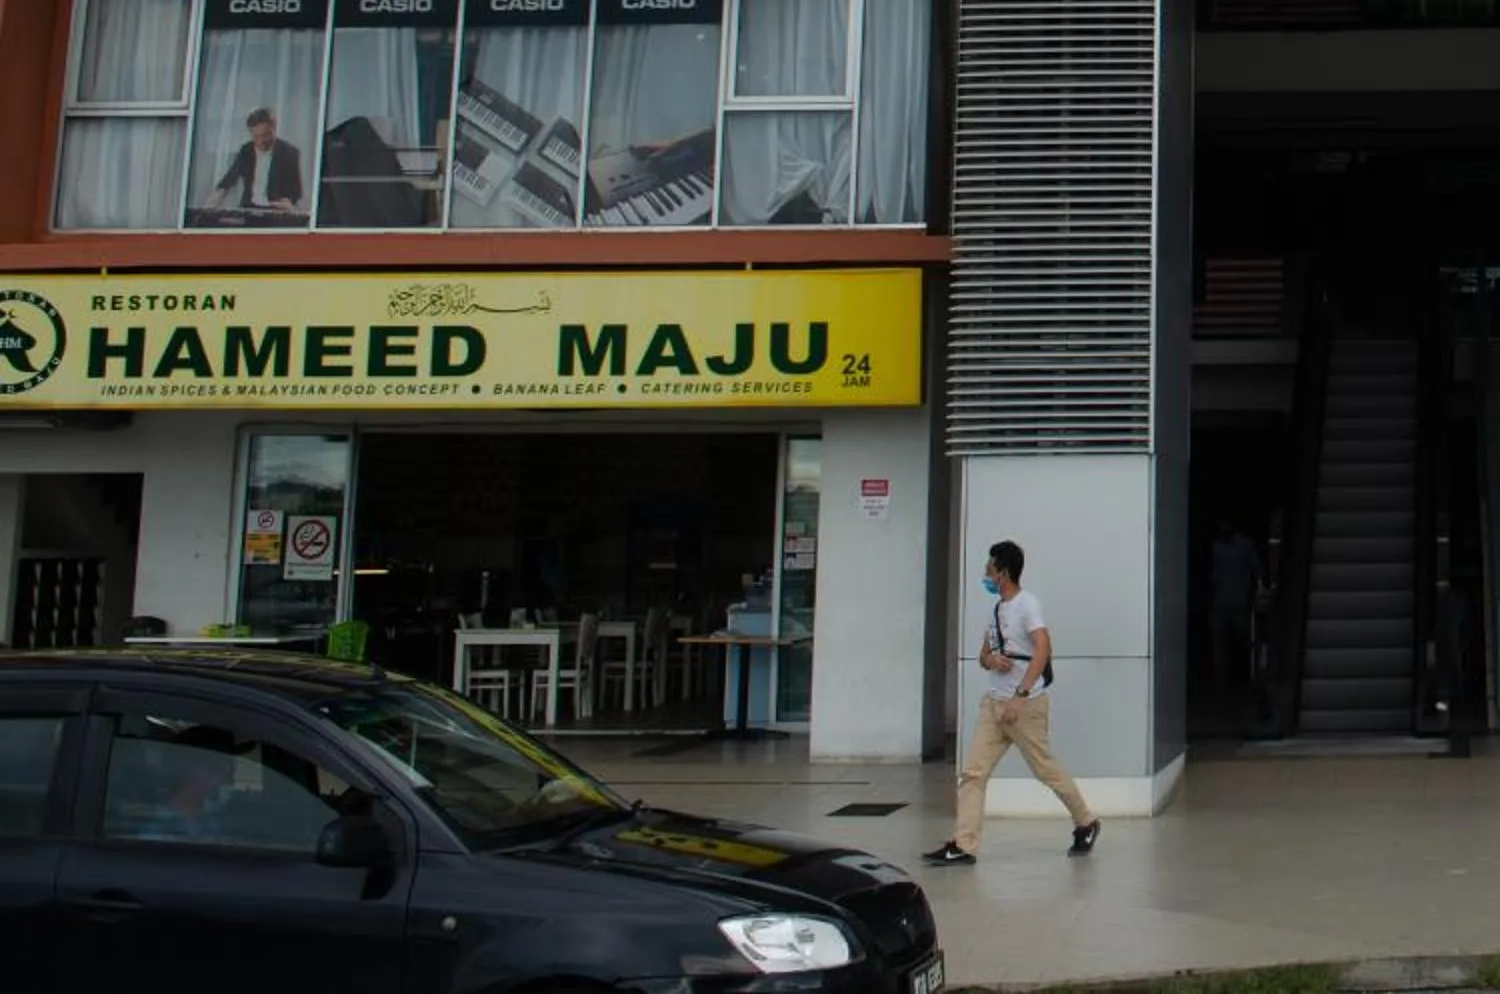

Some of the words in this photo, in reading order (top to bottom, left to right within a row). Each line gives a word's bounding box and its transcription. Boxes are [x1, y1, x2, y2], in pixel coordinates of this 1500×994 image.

[91, 294, 237, 311] RESTORAN
[86, 324, 487, 379] HAMEED
[557, 321, 829, 377] MAJU
[841, 353, 872, 375] 24
[101, 384, 157, 396] INDIAN
[160, 384, 218, 397] SPICES
[236, 384, 328, 396] MALAYSIAN
[331, 383, 378, 396] FOOD
[383, 383, 460, 395] CONCEPT
[493, 383, 560, 395] BANANA
[563, 383, 608, 395] LEAF
[641, 382, 724, 395] CATERING
[730, 381, 813, 394] SERVICES
[841, 376, 871, 388] JAM
